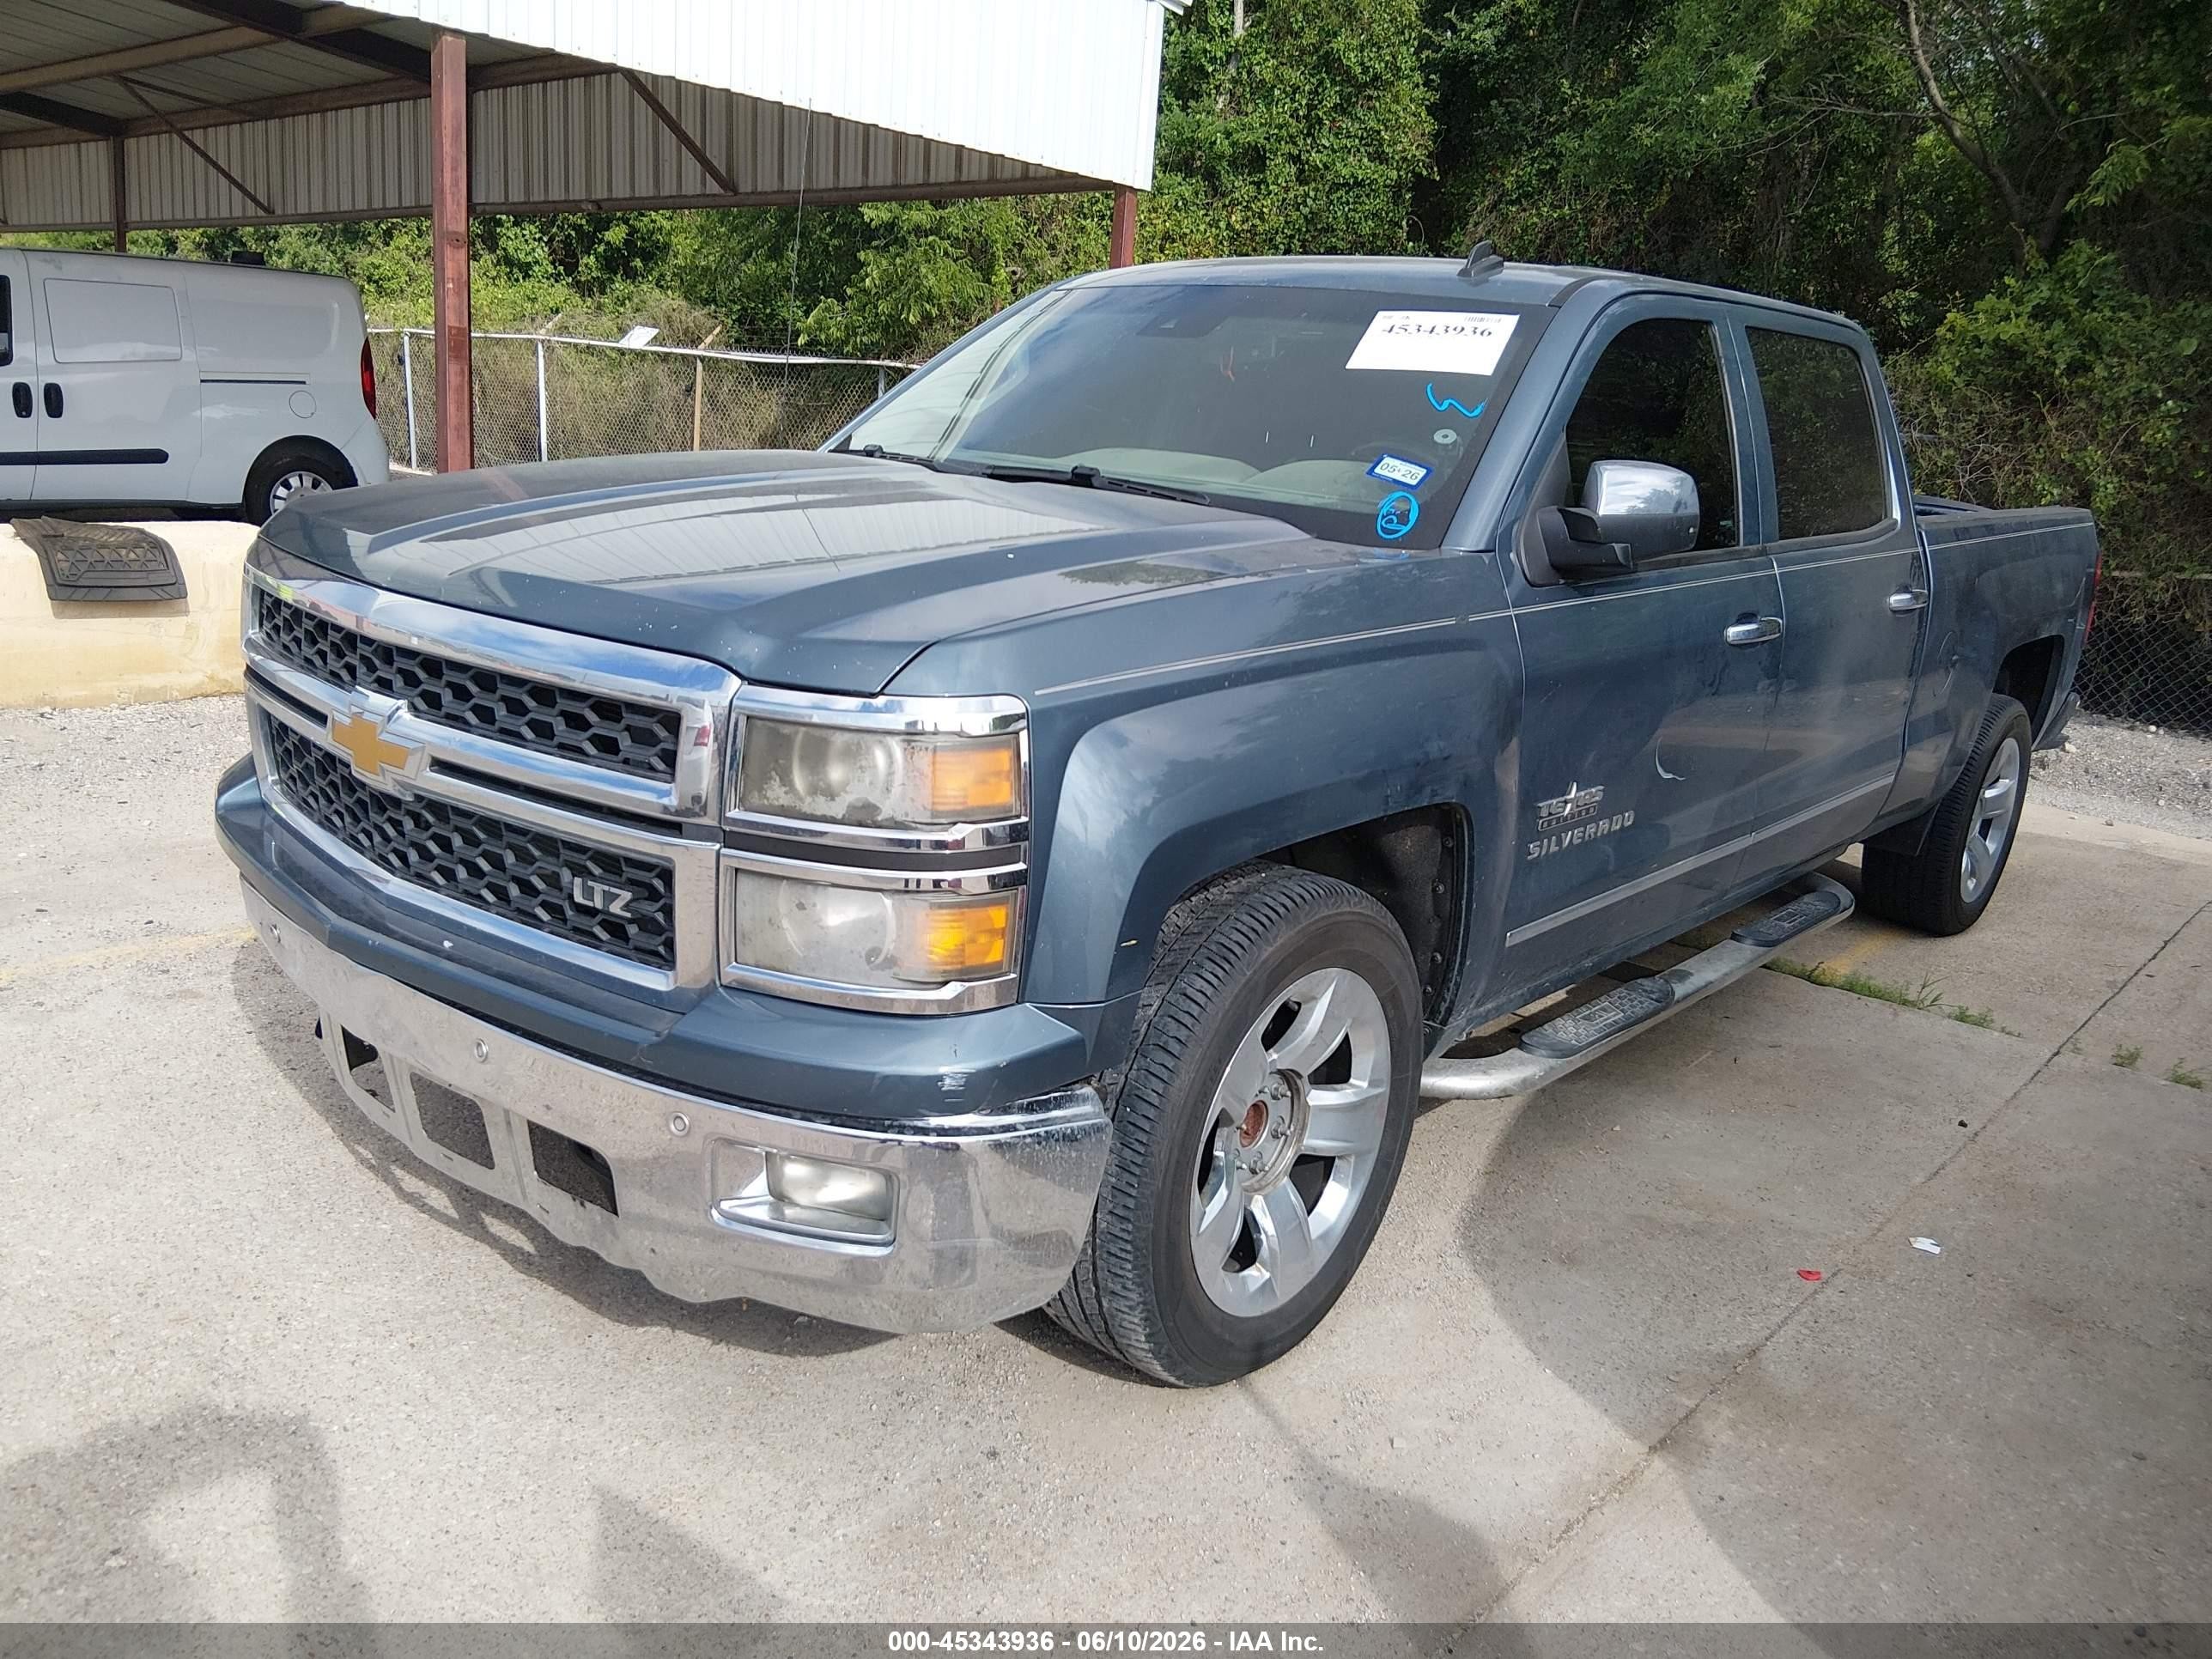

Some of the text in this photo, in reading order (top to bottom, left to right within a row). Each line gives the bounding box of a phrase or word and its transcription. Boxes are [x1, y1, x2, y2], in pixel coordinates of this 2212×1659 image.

[1382, 324, 1492, 337] 45343936
[1401, 469, 1421, 481] 26
[1528, 810, 1635, 860] SILVERADO
[573, 877, 633, 918] LTZ
